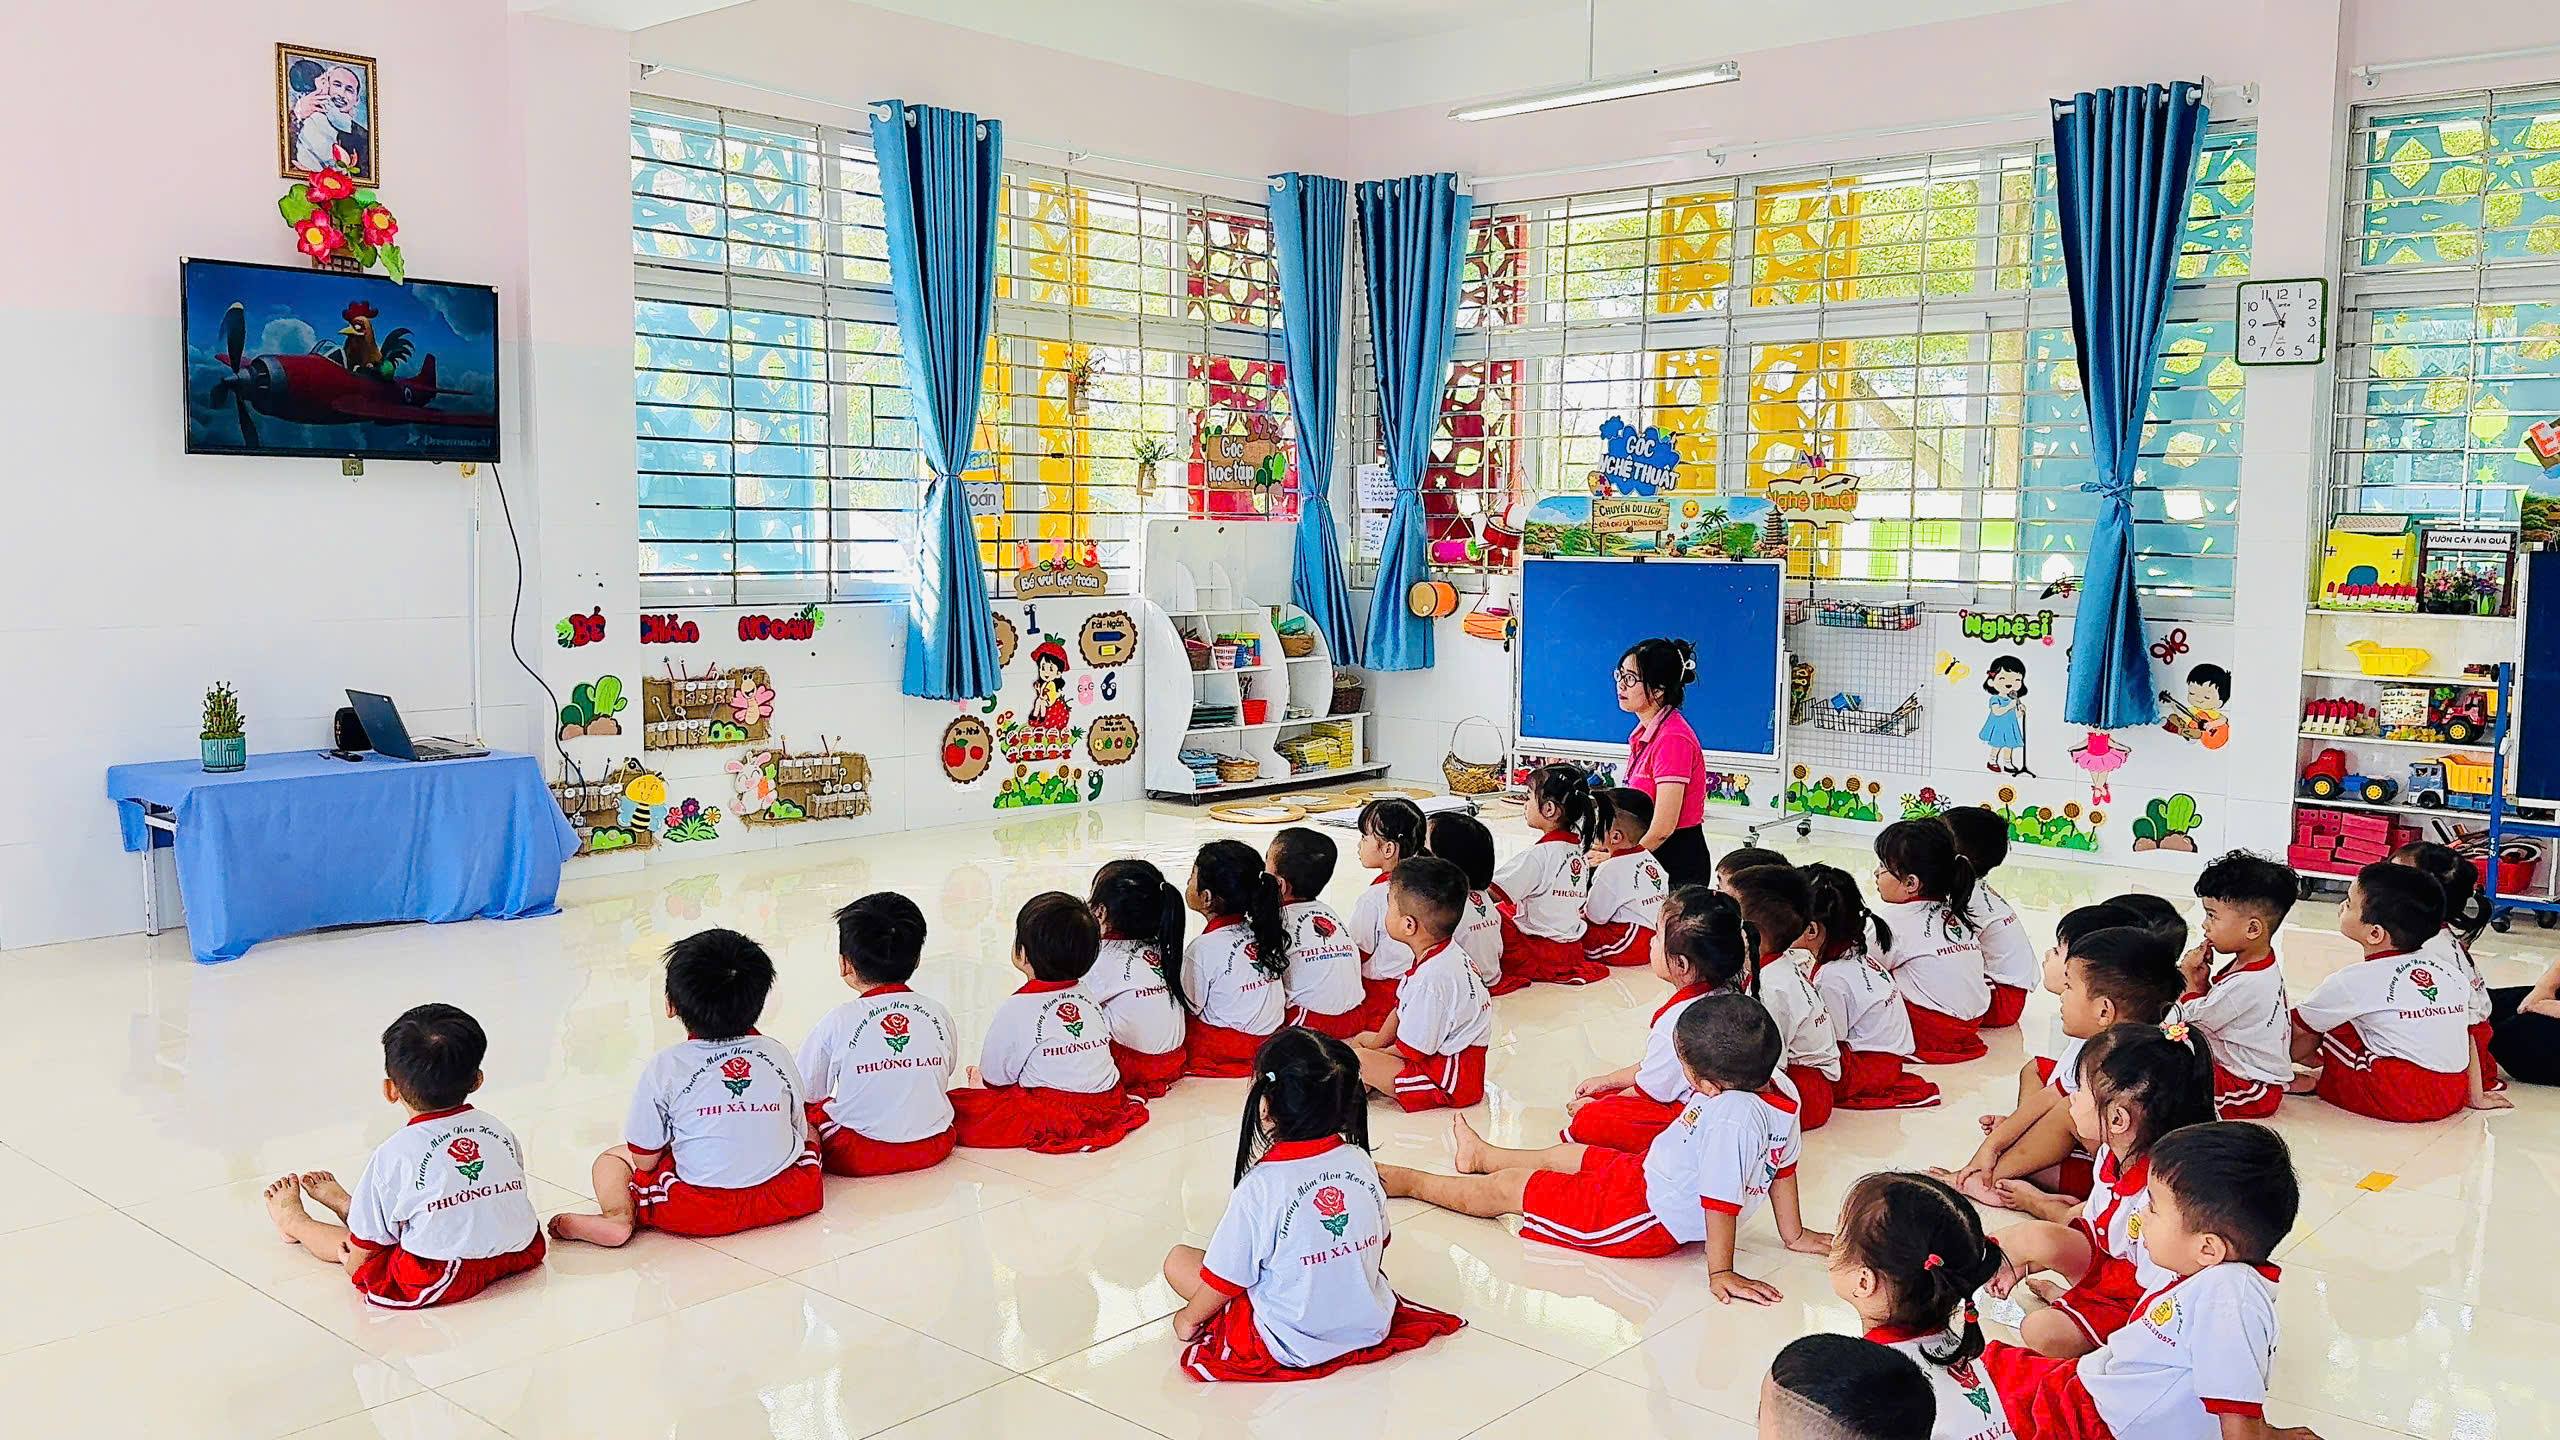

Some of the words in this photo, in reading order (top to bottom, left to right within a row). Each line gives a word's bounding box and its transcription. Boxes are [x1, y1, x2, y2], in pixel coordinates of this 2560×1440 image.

[2261, 289, 2269, 300] 11
[2276, 288, 2289, 300] 12
[2297, 288, 2302, 299] 1
[2247, 301, 2259, 312] 10
[2308, 298, 2317, 310] 2
[2248, 318, 2257, 328] 9
[2307, 316, 2317, 327] 3
[2247, 335, 2256, 346] 8
[2307, 333, 2315, 344] 4
[2259, 346, 2267, 357] 7
[2275, 346, 2285, 357] 6
[2294, 345, 2303, 356] 5
[1221, 436, 1244, 458] Góc
[1626, 433, 1656, 458] GÓC
[1207, 461, 1233, 485] học
[1233, 459, 1255, 487] tập
[1600, 455, 1633, 482] NGHỆ
[1634, 462, 1680, 490] THUẬT
[966, 488, 996, 506] oán
[1599, 502, 1631, 516] CHUYẾN
[1632, 504, 1643, 513] DU
[1643, 506, 1661, 516] LỊCH
[2454, 535, 2473, 544] CÂY
[1020, 573, 1036, 592] Bé
[1037, 571, 1054, 587] vui
[1056, 571, 1073, 588] học
[1074, 571, 1100, 588] toán
[1101, 671, 1117, 701] 6
[1088, 768, 1104, 802] 9
[2399, 1006, 2446, 1020] PHƯỜNG
[848, 1018, 868, 1050] Trường
[868, 1005, 888, 1020] Mầm
[890, 1000, 910, 1010] Non
[912, 1003, 930, 1018] Hoa
[1042, 1041, 1091, 1057] PHƯỜNG
[682, 1067, 706, 1095] Trường
[705, 1050, 728, 1068] Mầm
[730, 1046, 753, 1055] Non
[756, 1050, 775, 1067] Hoa
[856, 1058, 912, 1075] PHƯỜNG
[916, 1056, 942, 1067] LAGI
[697, 1104, 722, 1116] THỊ
[727, 1101, 746, 1113] XÃ
[750, 1103, 780, 1113] LAGI
[415, 1151, 433, 1191] Trường
[430, 1131, 451, 1152] Mầm
[453, 1125, 475, 1135] Non
[478, 1125, 500, 1140] Hoa
[427, 1185, 492, 1213] PHƯỜNG
[494, 1180, 523, 1195] LAGI
[1279, 1199, 1300, 1240] Trường
[1298, 1178, 1318, 1200] Mầm
[1319, 1171, 1341, 1182] Non
[1345, 1171, 1366, 1187] Hoa
[1300, 1251, 1327, 1266] THỊ
[1331, 1242, 1352, 1259] XÃ
[1355, 1234, 1378, 1251] LAGI
